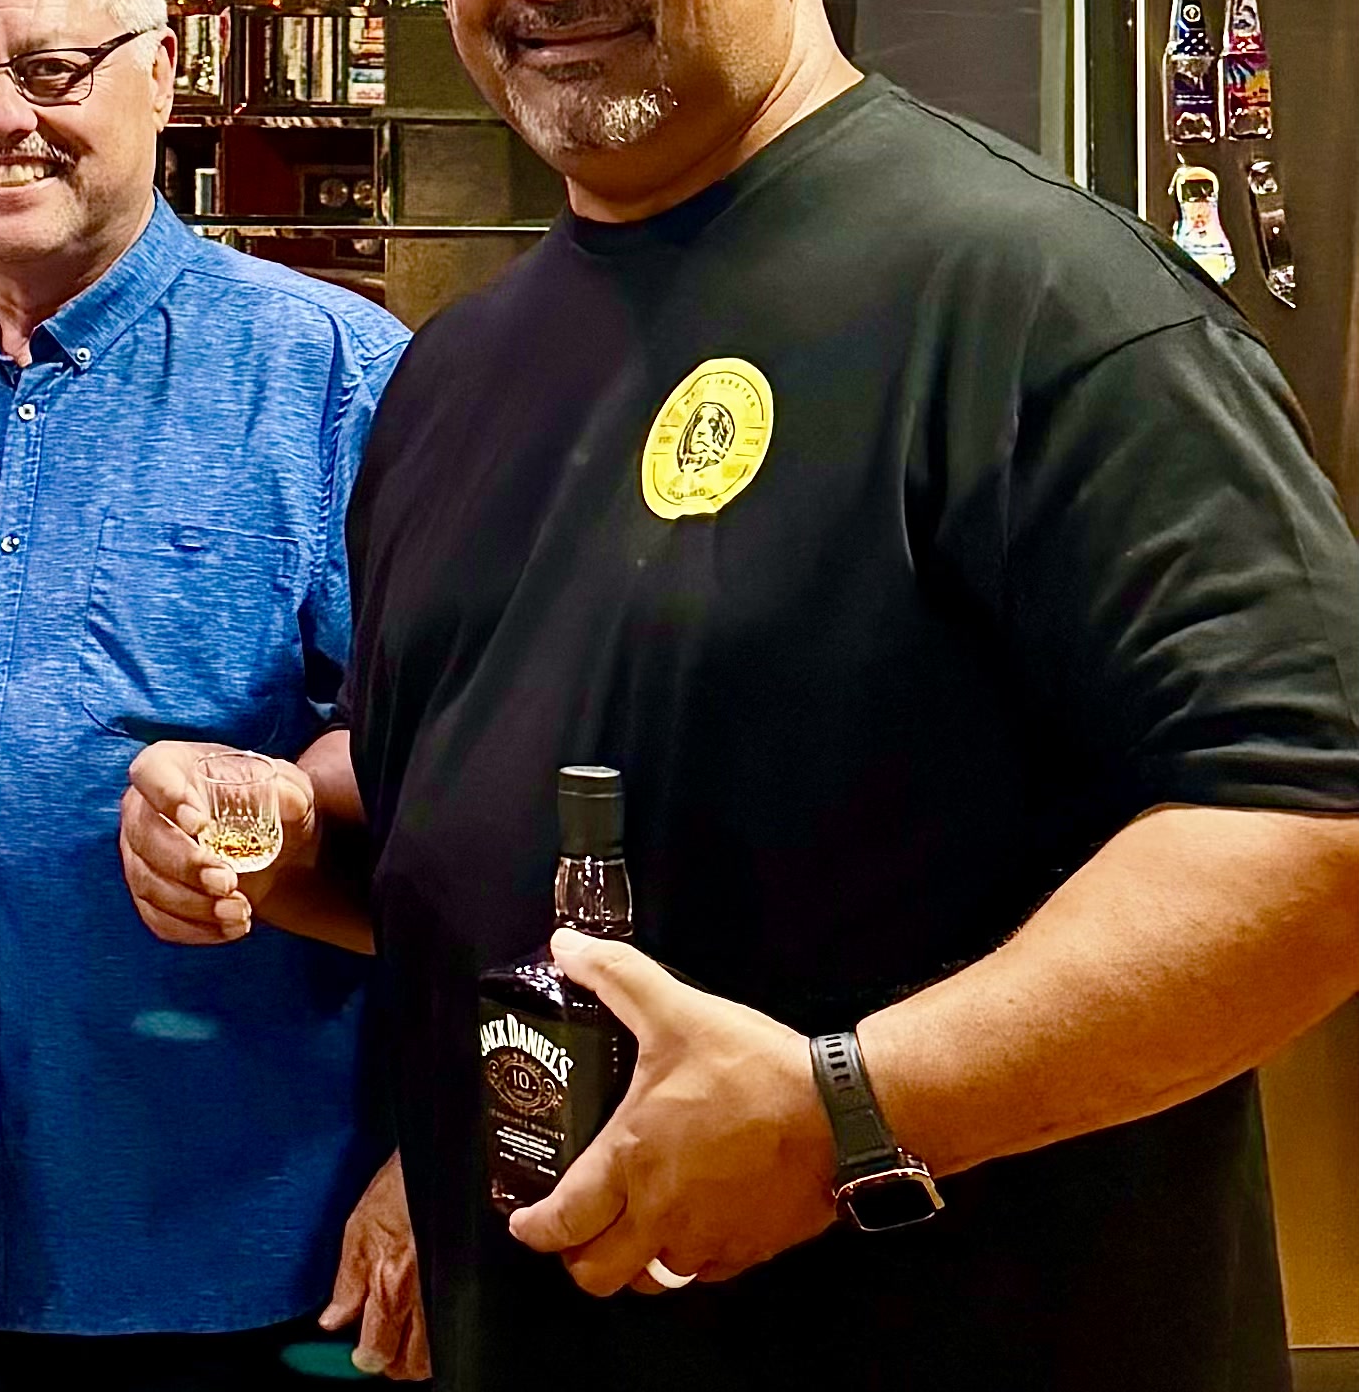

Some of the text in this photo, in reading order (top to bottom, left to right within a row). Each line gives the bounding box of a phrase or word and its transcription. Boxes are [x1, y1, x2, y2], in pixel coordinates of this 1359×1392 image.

[481, 1012, 574, 1088] JACK DANIEL'S
[512, 1069, 530, 1090] 10
